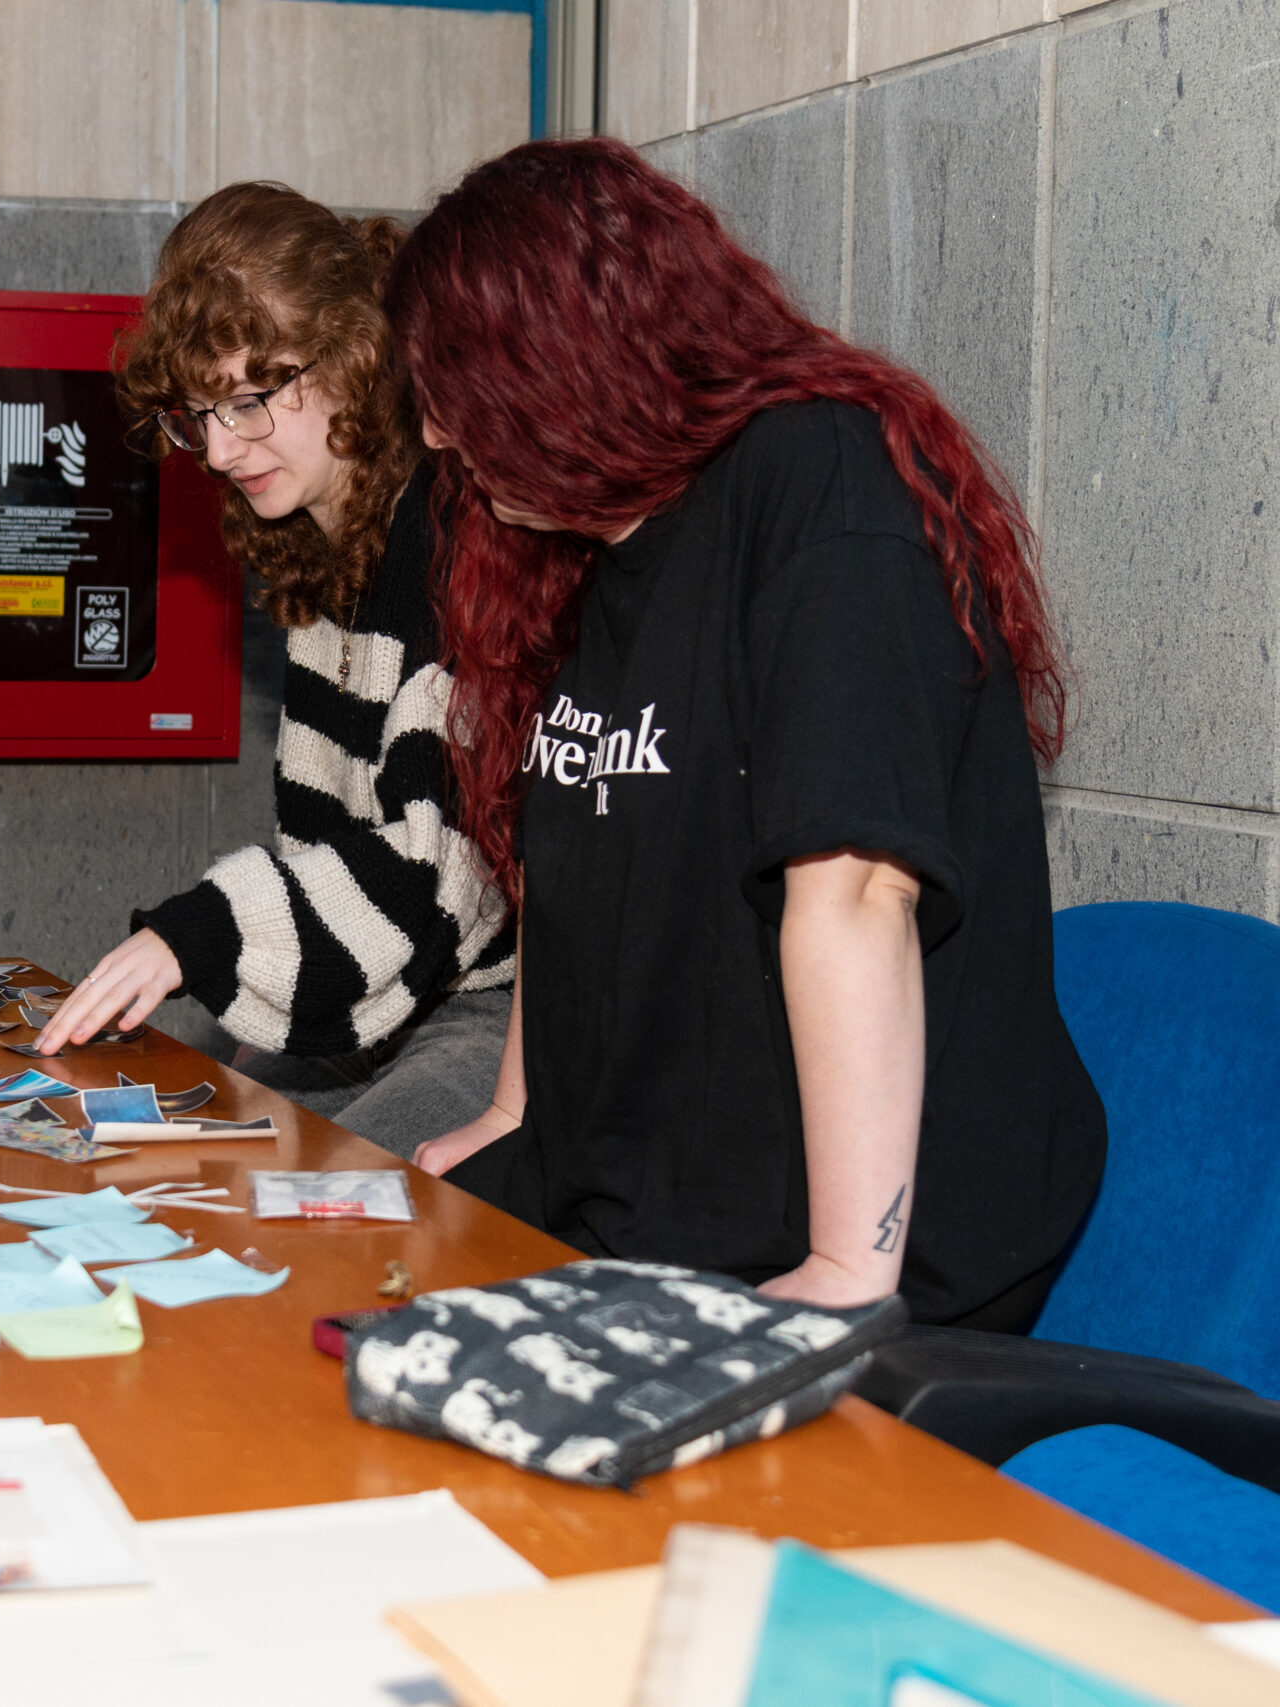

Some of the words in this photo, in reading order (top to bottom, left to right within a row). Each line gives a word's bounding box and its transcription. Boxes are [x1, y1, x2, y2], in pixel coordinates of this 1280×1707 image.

[5, 507, 51, 518] ISTRUZIONI
[88, 594, 117, 606] POLY
[83, 607, 121, 619] GLASS
[595, 780, 609, 816] It
